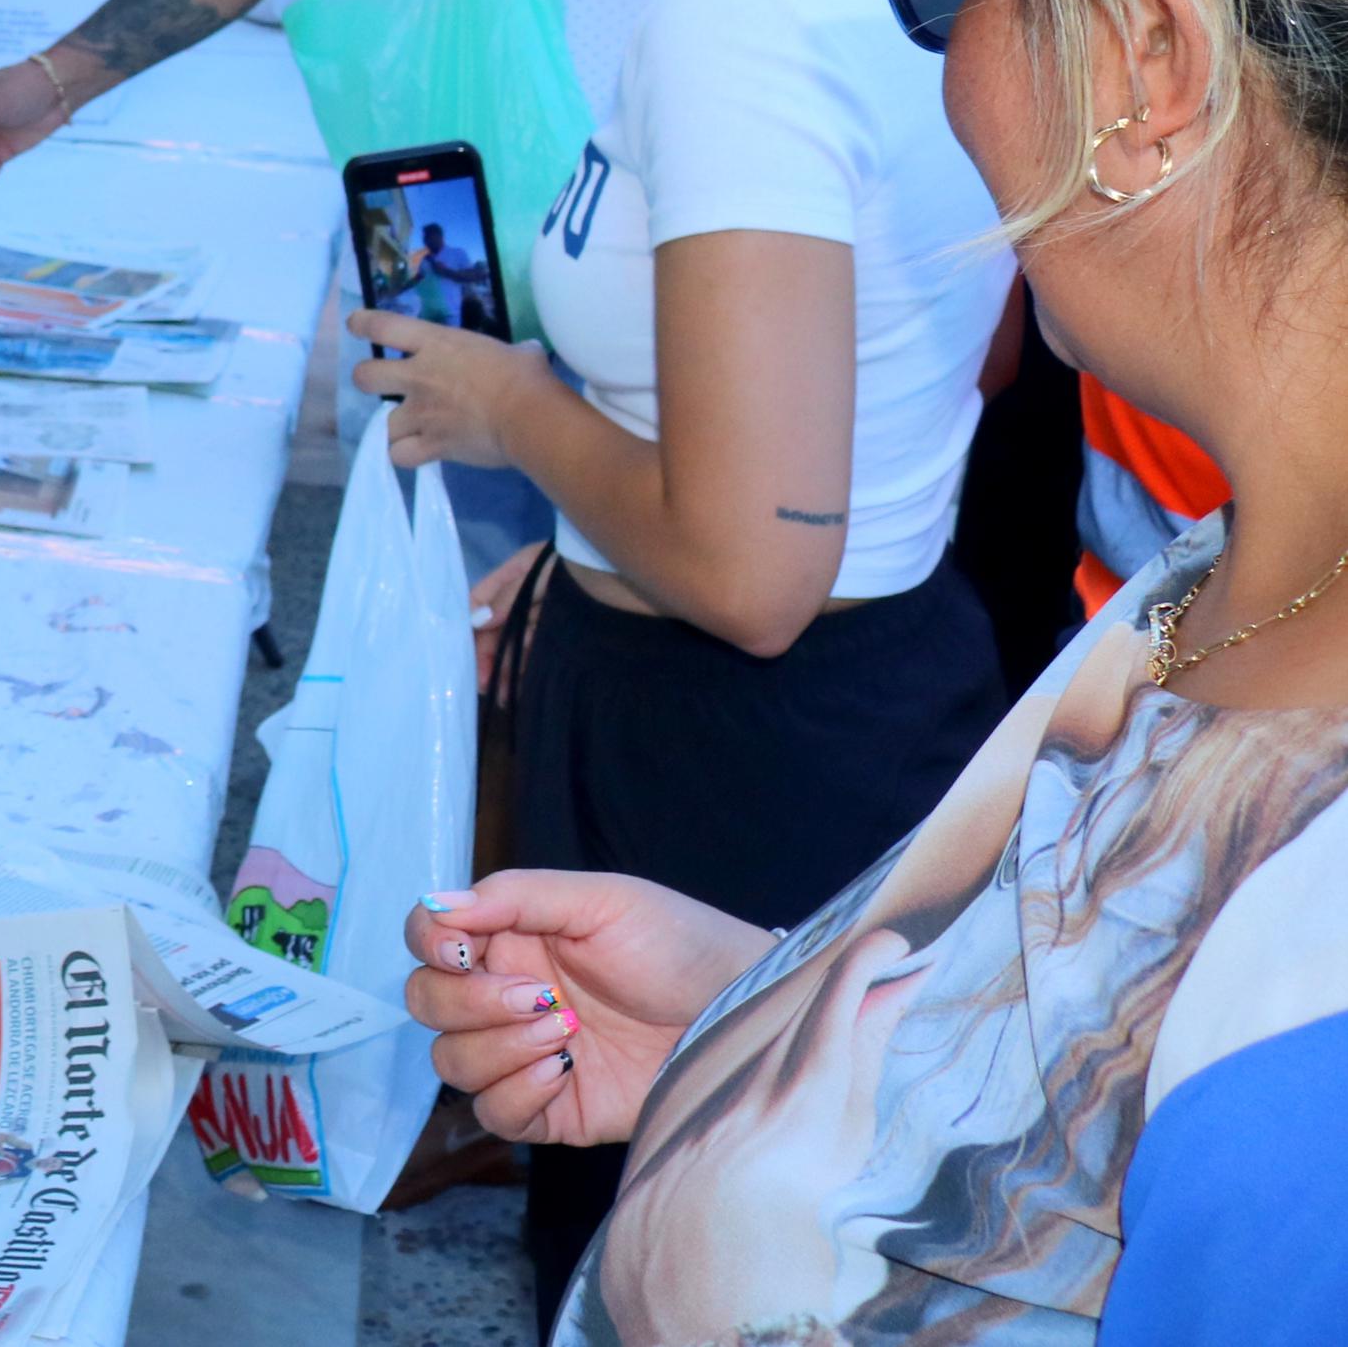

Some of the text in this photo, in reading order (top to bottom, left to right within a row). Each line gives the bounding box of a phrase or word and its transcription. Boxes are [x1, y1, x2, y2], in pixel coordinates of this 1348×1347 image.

[7, 958, 19, 977] AL
[21, 955, 36, 1003] CHUMI
[60, 950, 109, 1012] El
[8, 978, 22, 1050] ANDORRA
[23, 1005, 38, 1062] ORTEGA
[7, 1050, 21, 1068] DE
[20, 1063, 37, 1081] SE
[57, 1015, 111, 1142] Norte
[44, 1147, 98, 1184] de
